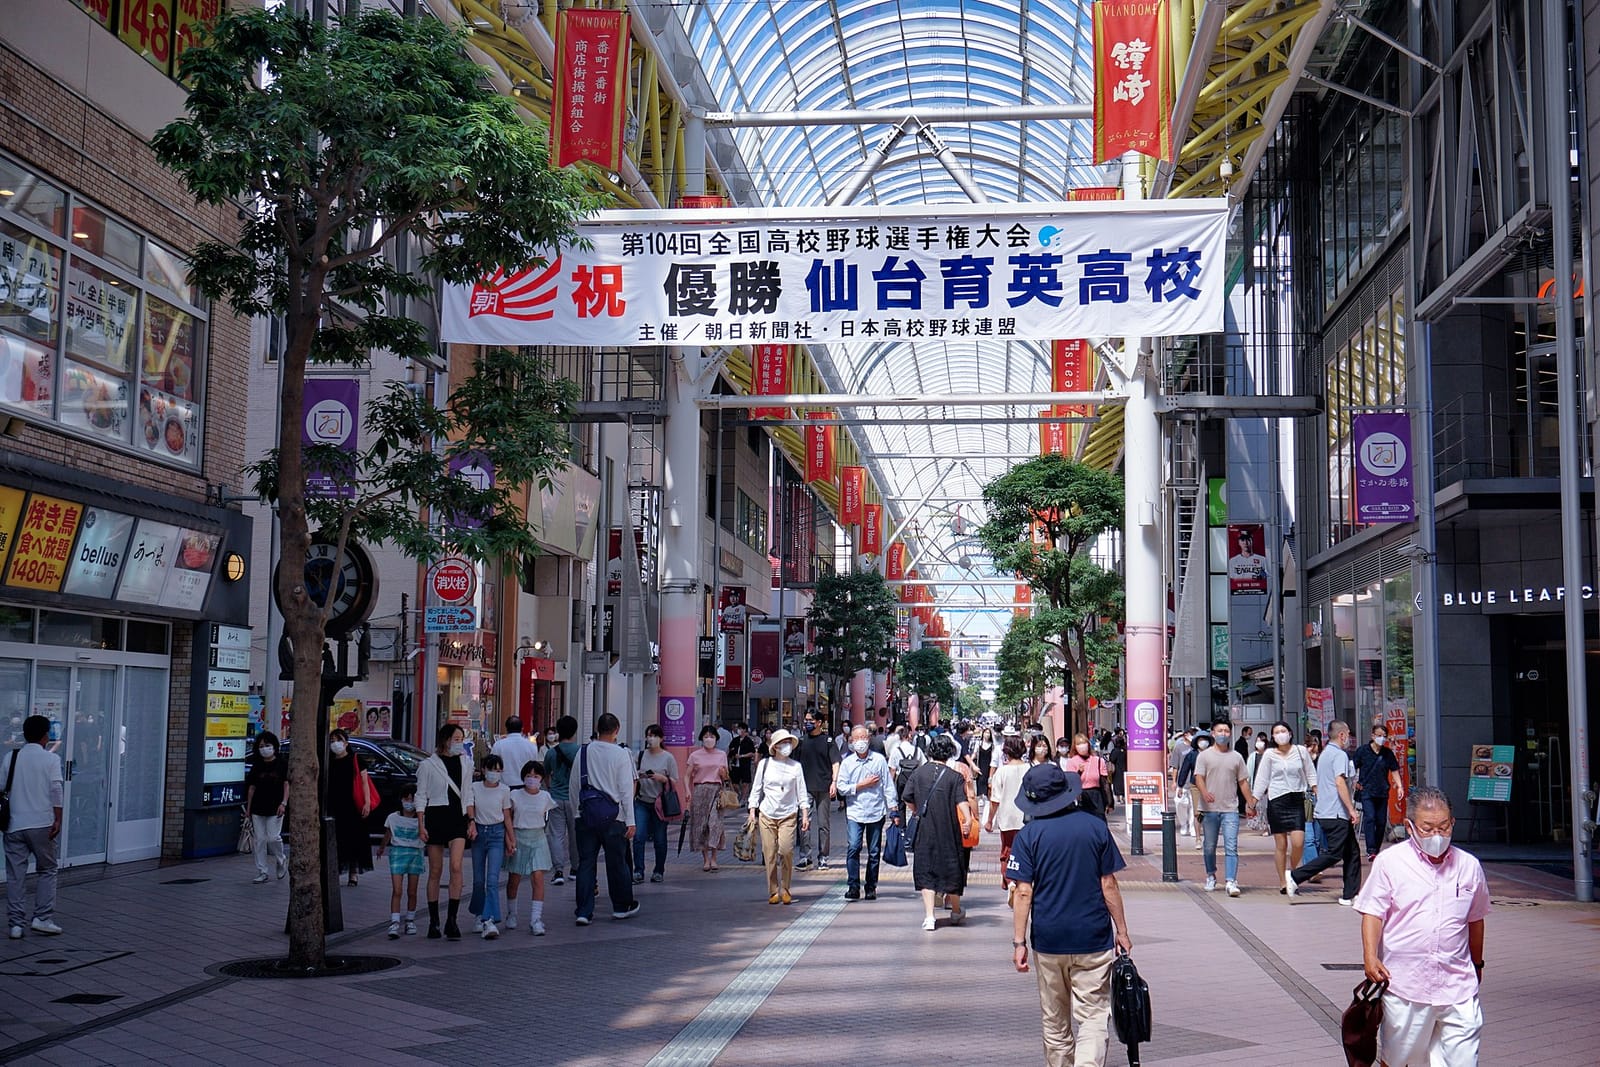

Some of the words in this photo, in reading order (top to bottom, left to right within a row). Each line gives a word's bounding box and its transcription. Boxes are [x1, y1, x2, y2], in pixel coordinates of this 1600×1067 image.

[1104, 3, 1157, 17] VLANDOME
[593, 34, 611, 104] 一番町一番街
[569, 40, 588, 133] 商店街振興組合
[571, 264, 627, 319] 祝
[663, 260, 783, 317] 優勝
[805, 246, 1202, 313] 仙台育英高校
[25, 499, 78, 537] 焼き鳥
[17, 532, 71, 561] 食べ放題
[80, 543, 119, 568] bellus
[436, 575, 467, 591] 消火栓
[1444, 591, 1496, 606] BLUE
[1510, 587, 1565, 603] LEAF
[700, 640, 715, 648] ABC
